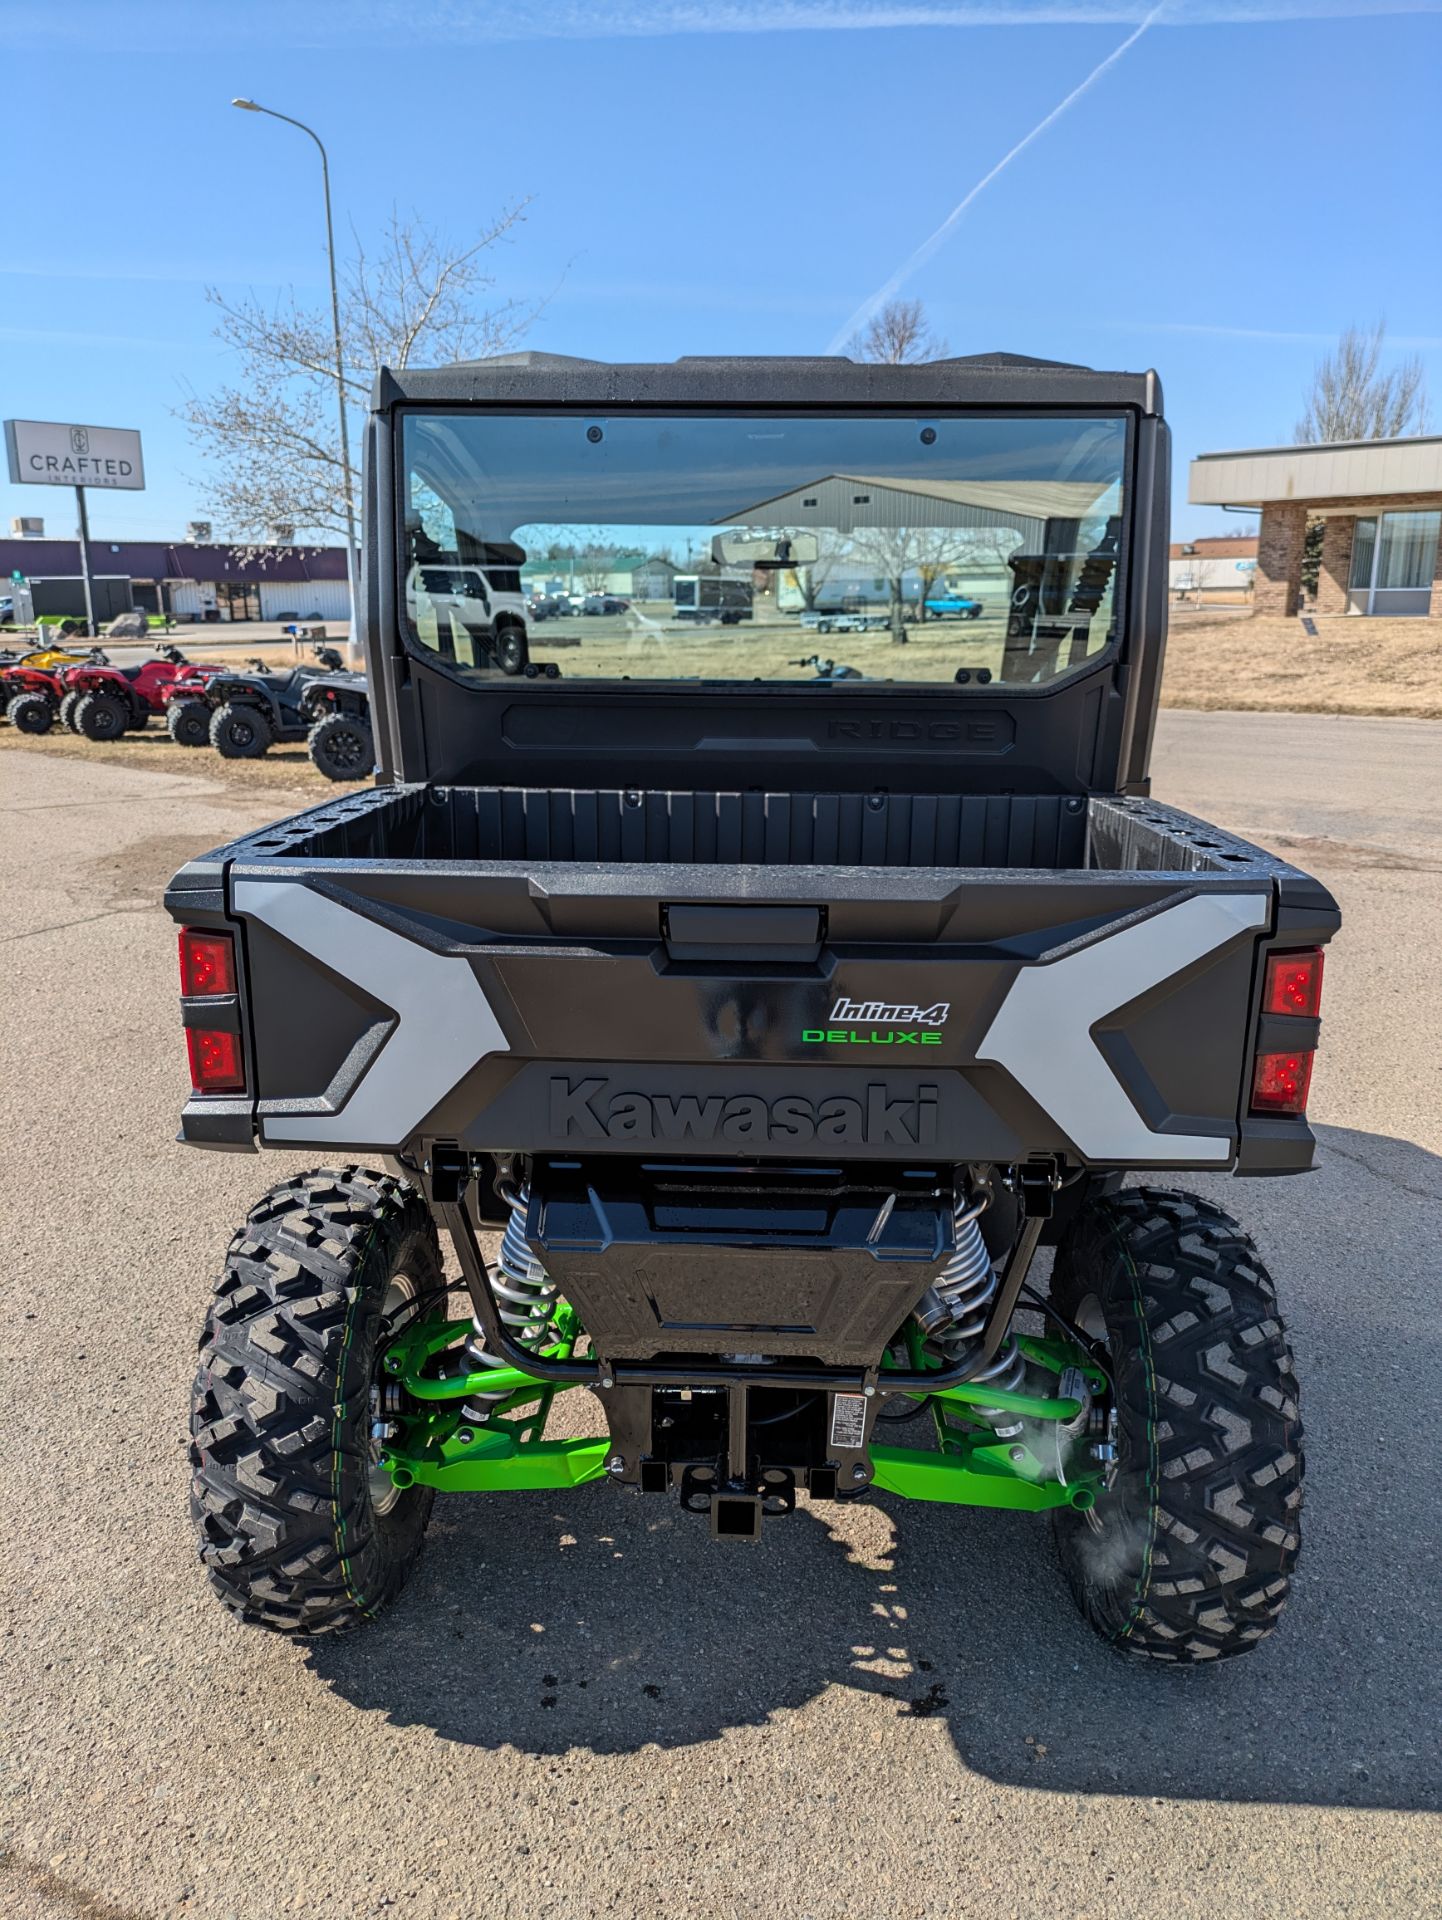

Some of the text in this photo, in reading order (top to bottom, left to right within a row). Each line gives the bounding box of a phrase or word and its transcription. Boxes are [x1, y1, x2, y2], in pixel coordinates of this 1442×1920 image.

[30, 455, 133, 476] CRAFTED
[48, 475, 118, 485] INTERIORS
[828, 719, 998, 741] RIDGE
[829, 998, 951, 1026] Inline-4
[802, 1029, 943, 1045] DELUXE
[549, 1076, 939, 1145] Kawasaki
